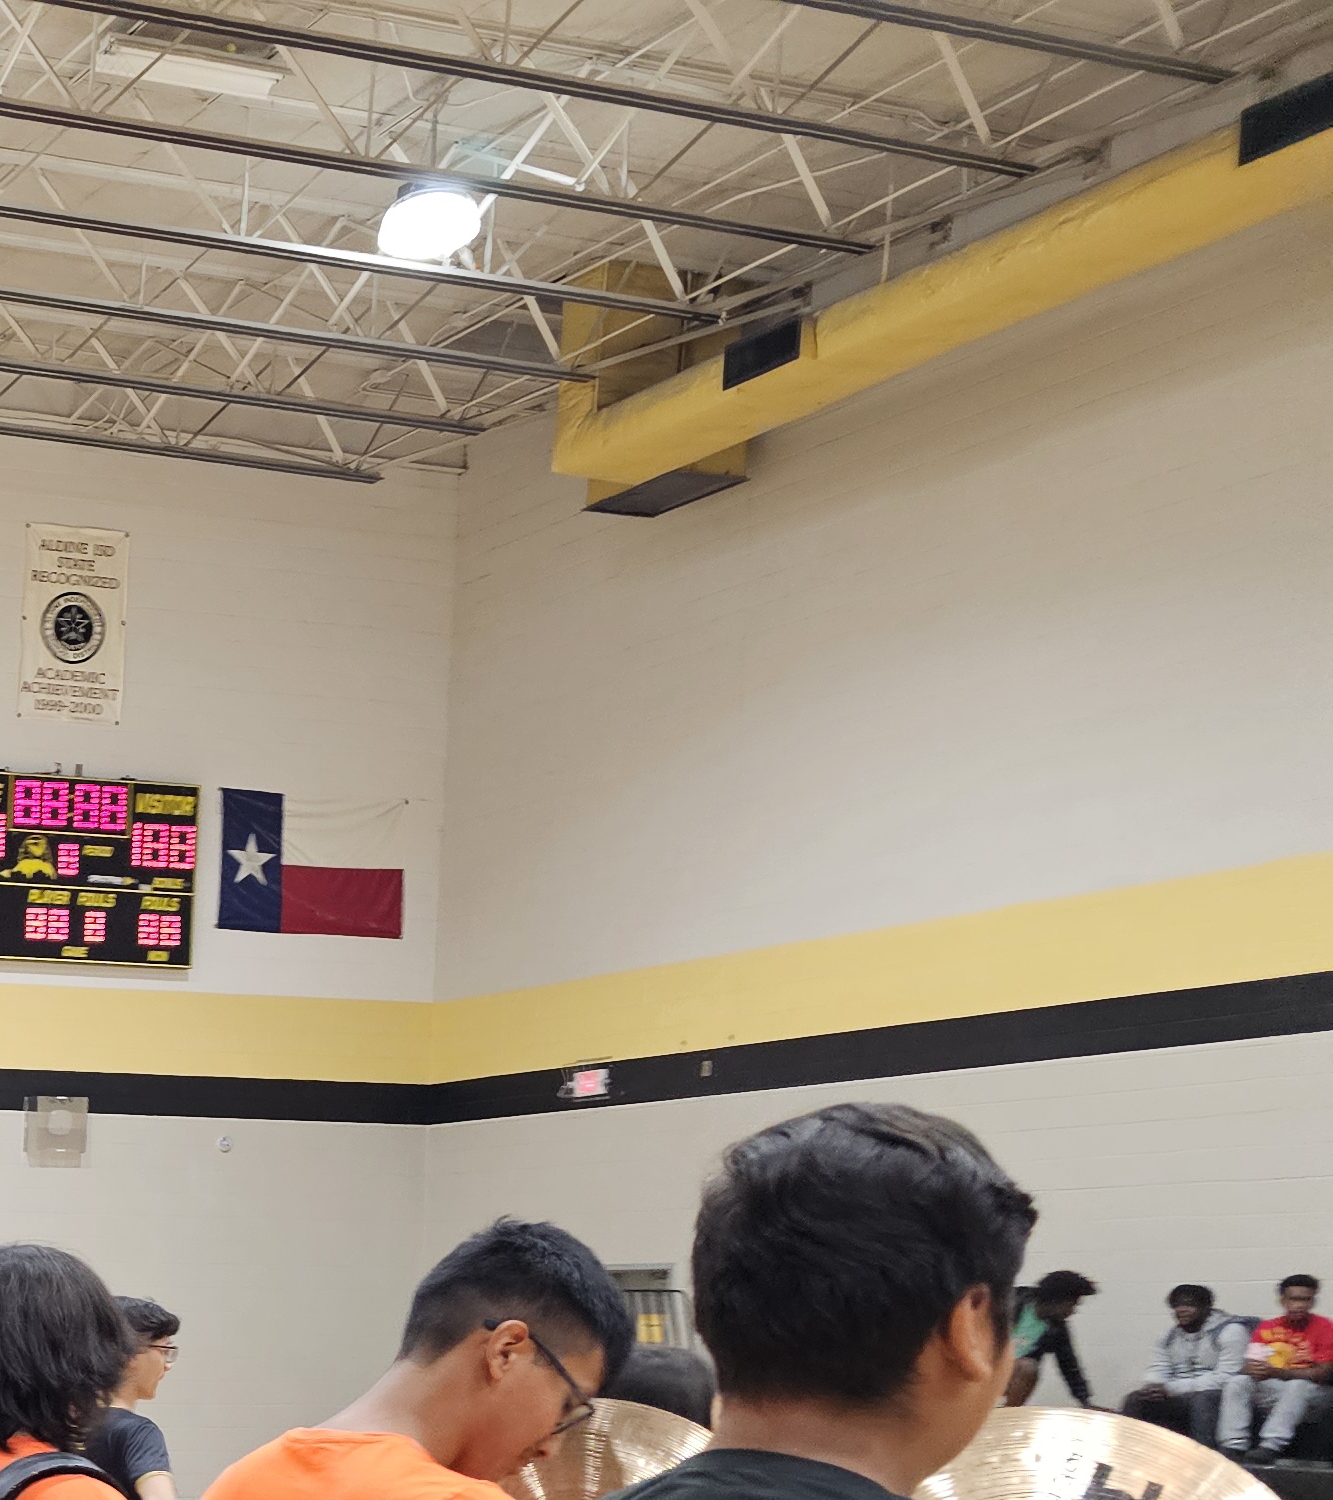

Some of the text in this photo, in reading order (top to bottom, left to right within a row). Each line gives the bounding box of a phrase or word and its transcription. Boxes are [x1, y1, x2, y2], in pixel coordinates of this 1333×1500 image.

[40, 539, 89, 555] ALDINE
[58, 557, 96, 573] STATE
[31, 570, 121, 590] RECOGNIZED
[35, 667, 106, 685] ACADEMIC
[136, 793, 196, 817] VISITOR
[28, 889, 118, 908] PLAYER FOULS
[140, 897, 182, 912] FOULS
